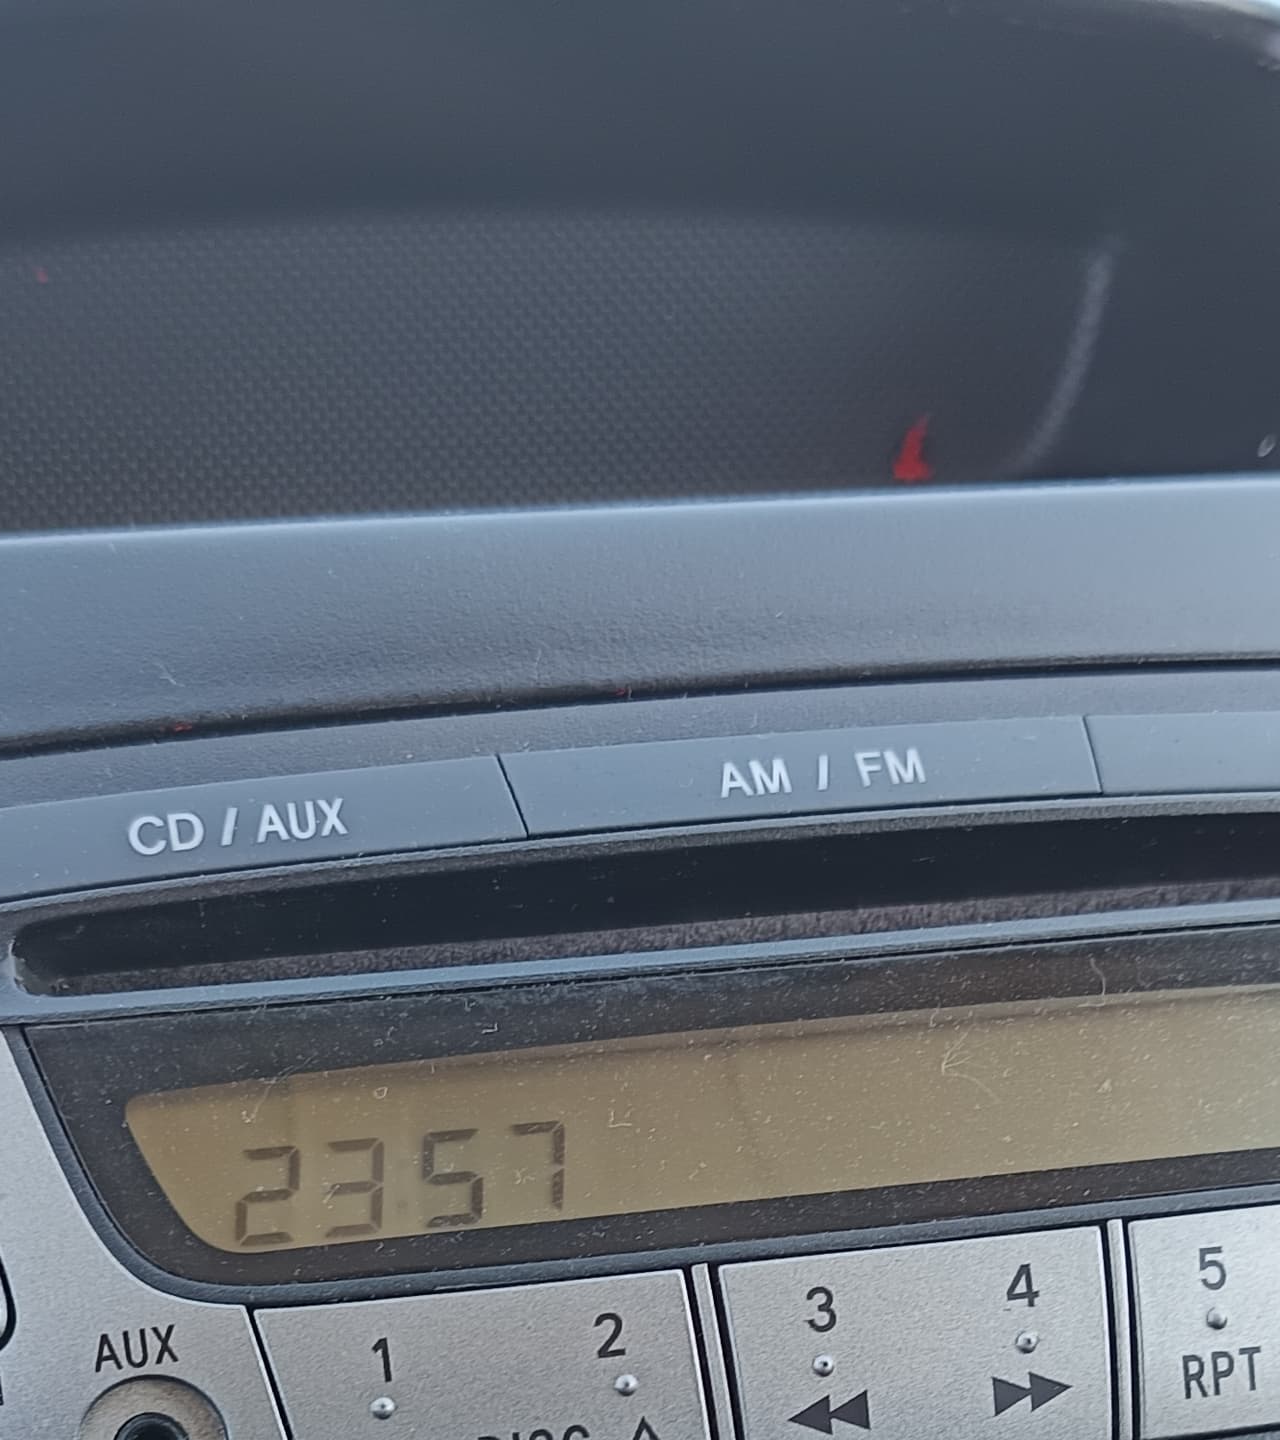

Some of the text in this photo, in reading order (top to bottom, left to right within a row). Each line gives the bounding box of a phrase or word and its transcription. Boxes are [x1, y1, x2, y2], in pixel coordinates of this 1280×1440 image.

[720, 747, 927, 799] AM / FM
[127, 798, 348, 856] CD / AUX
[234, 1119, 566, 1247] 2357
[1005, 1262, 1041, 1308] 4
[1197, 1245, 1228, 1291] 5
[803, 1286, 838, 1333] 3
[94, 1323, 179, 1373] AUX
[371, 1336, 393, 1383] 1
[593, 1311, 628, 1359] 2
[1181, 1345, 1263, 1400] RPT
